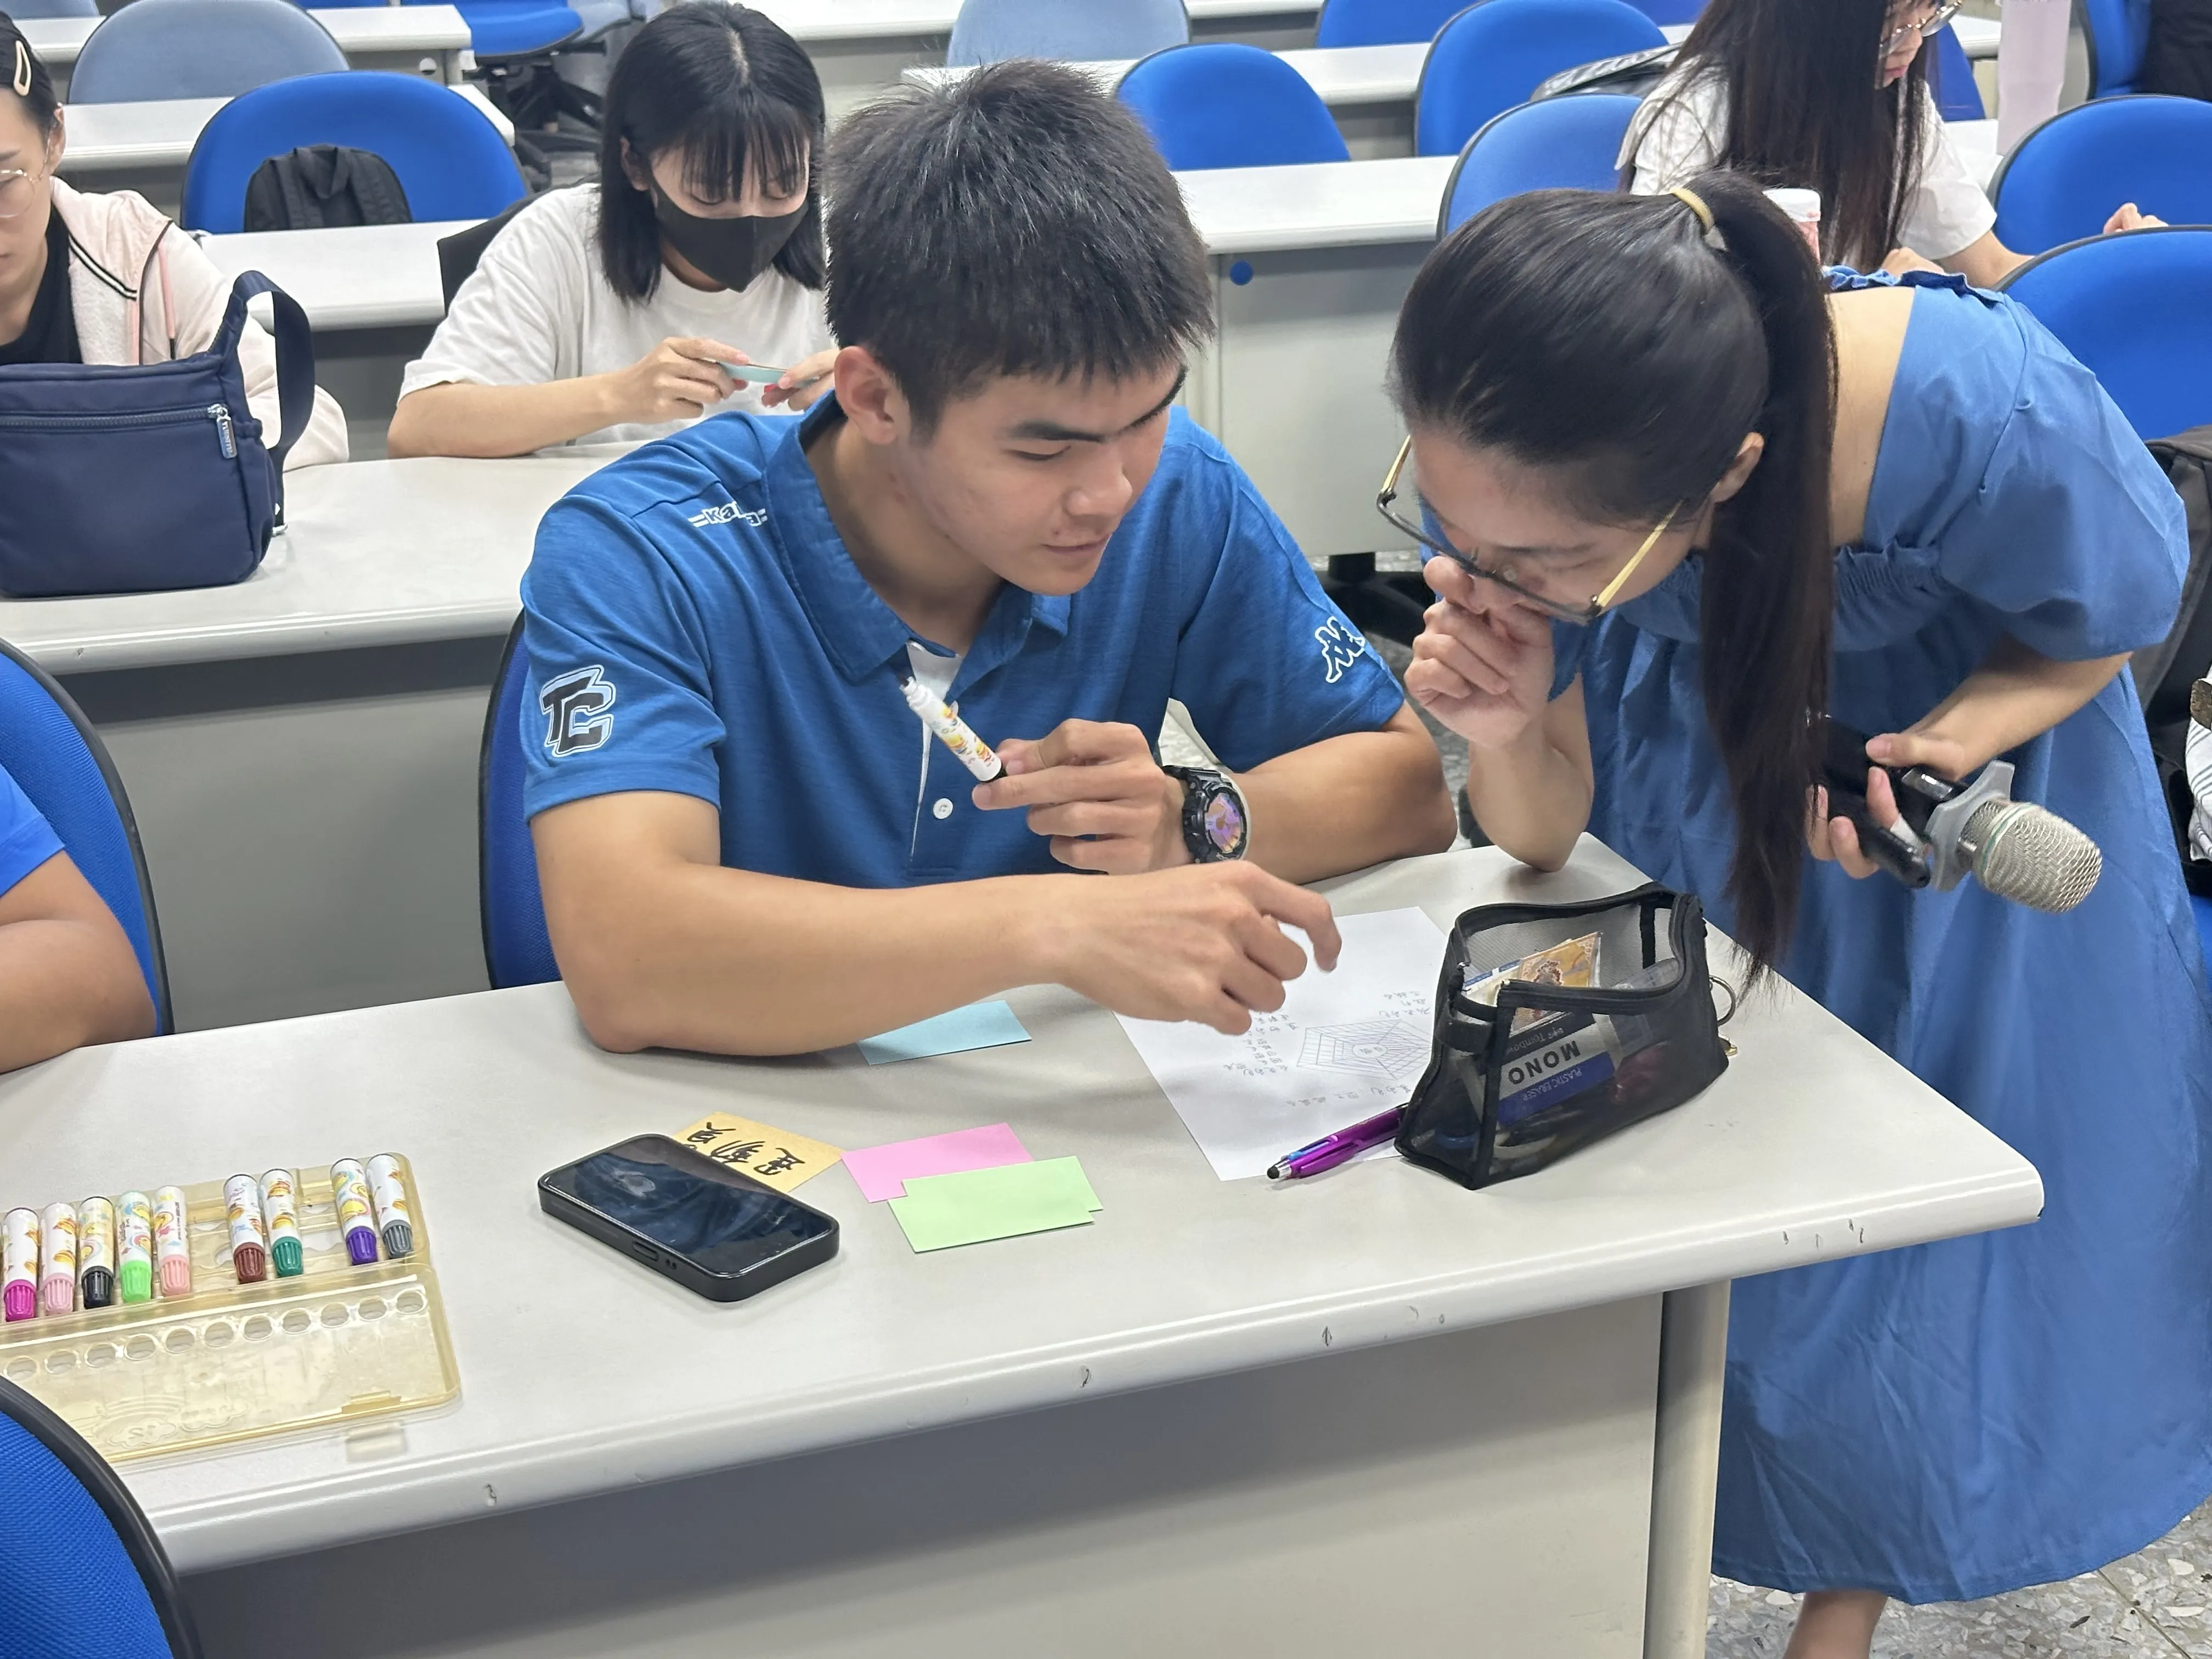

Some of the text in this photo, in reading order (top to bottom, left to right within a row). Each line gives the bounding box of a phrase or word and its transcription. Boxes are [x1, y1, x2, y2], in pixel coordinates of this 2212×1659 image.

[539, 664, 616, 758] TC
[1508, 1040, 1581, 1079] MONO
[1521, 1066, 1582, 1101] PLASTIC ERASER
